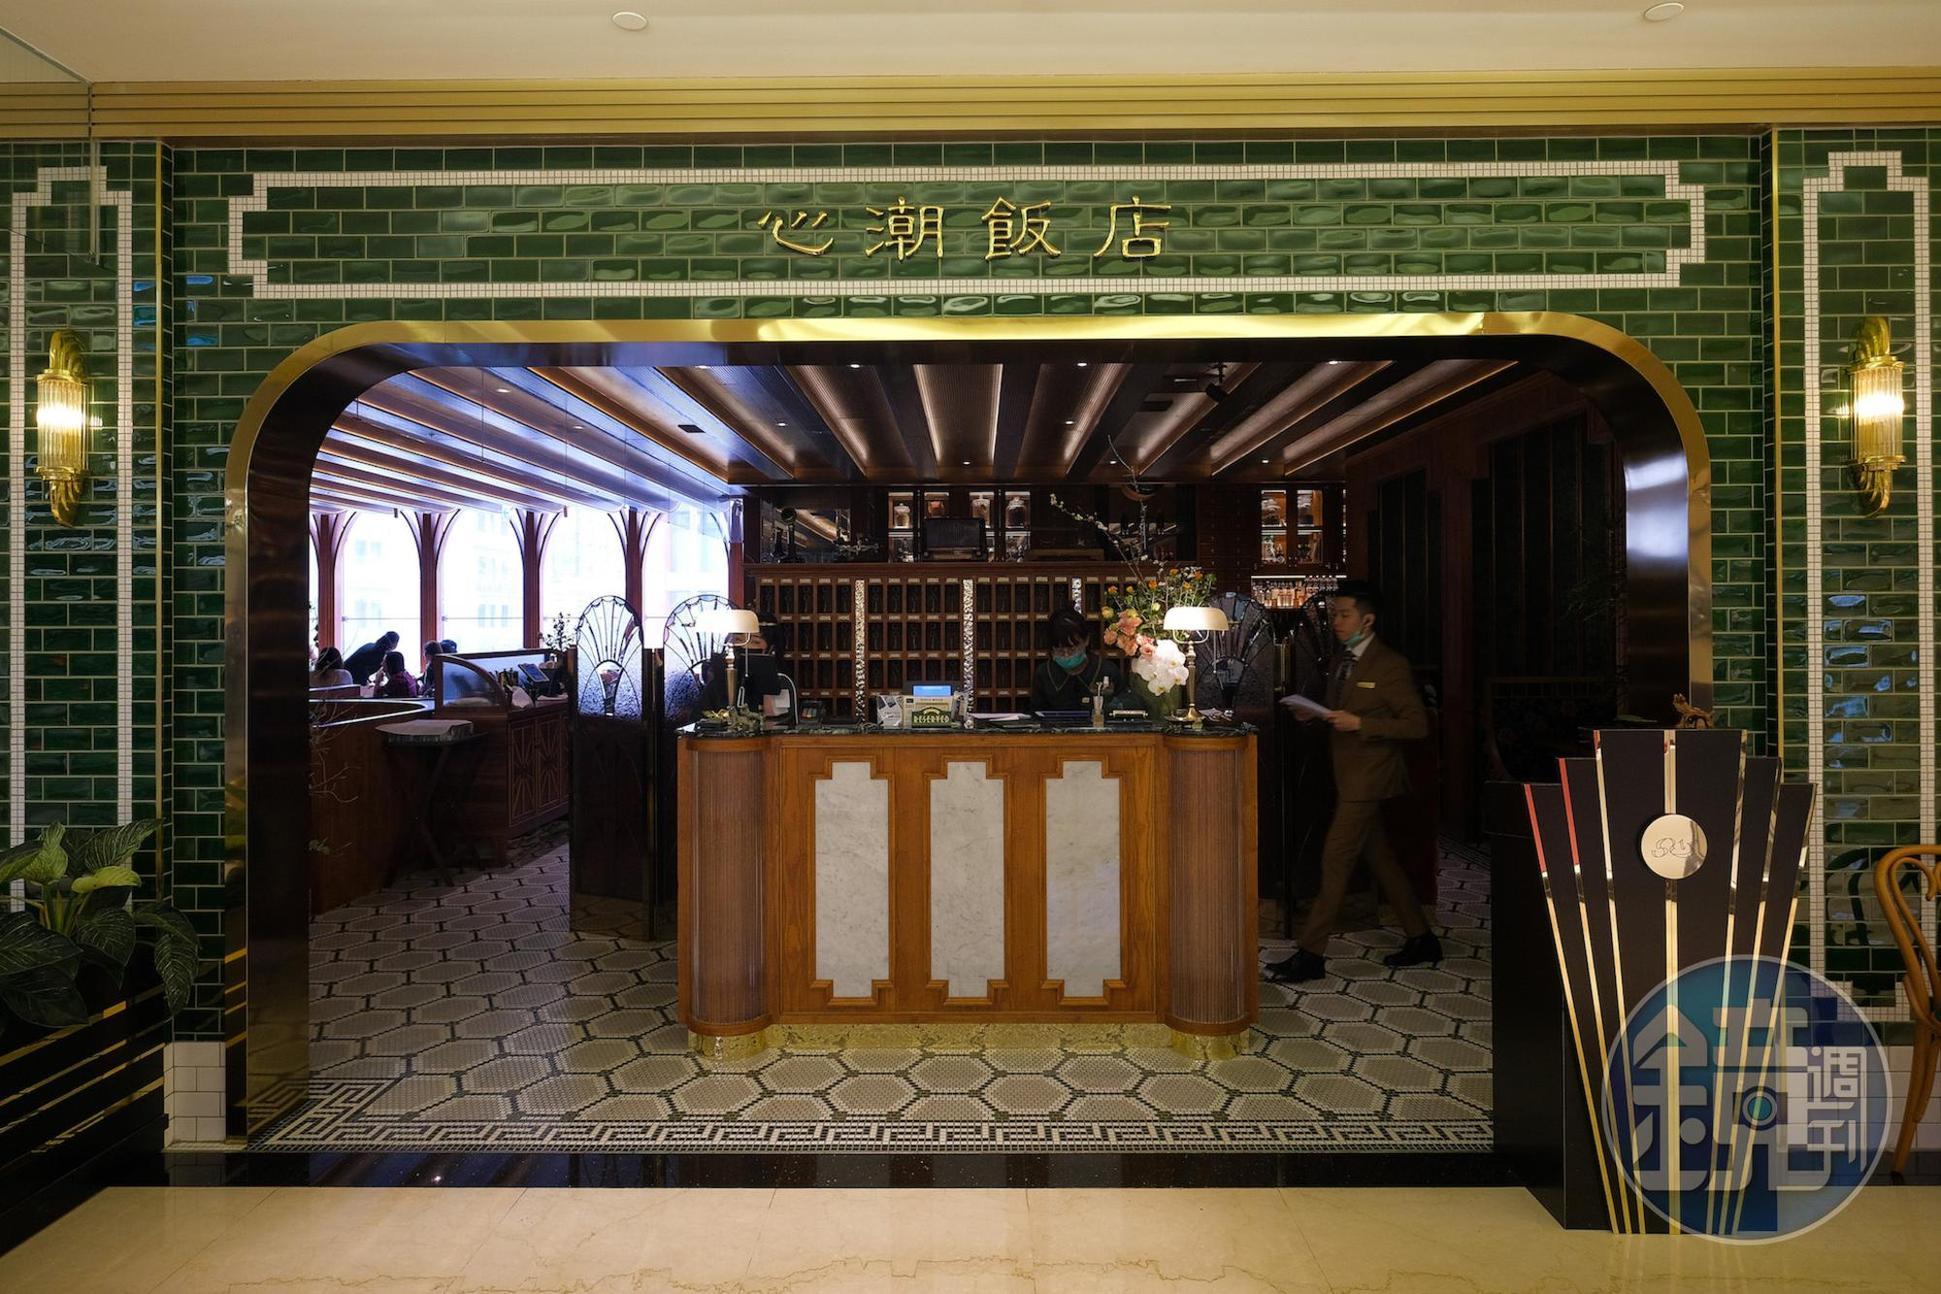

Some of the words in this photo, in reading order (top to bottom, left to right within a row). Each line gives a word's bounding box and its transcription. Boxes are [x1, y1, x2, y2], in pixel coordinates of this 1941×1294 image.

[757, 196, 1172, 261] 心潮飯店
[913, 714, 950, 724] RESERVED
